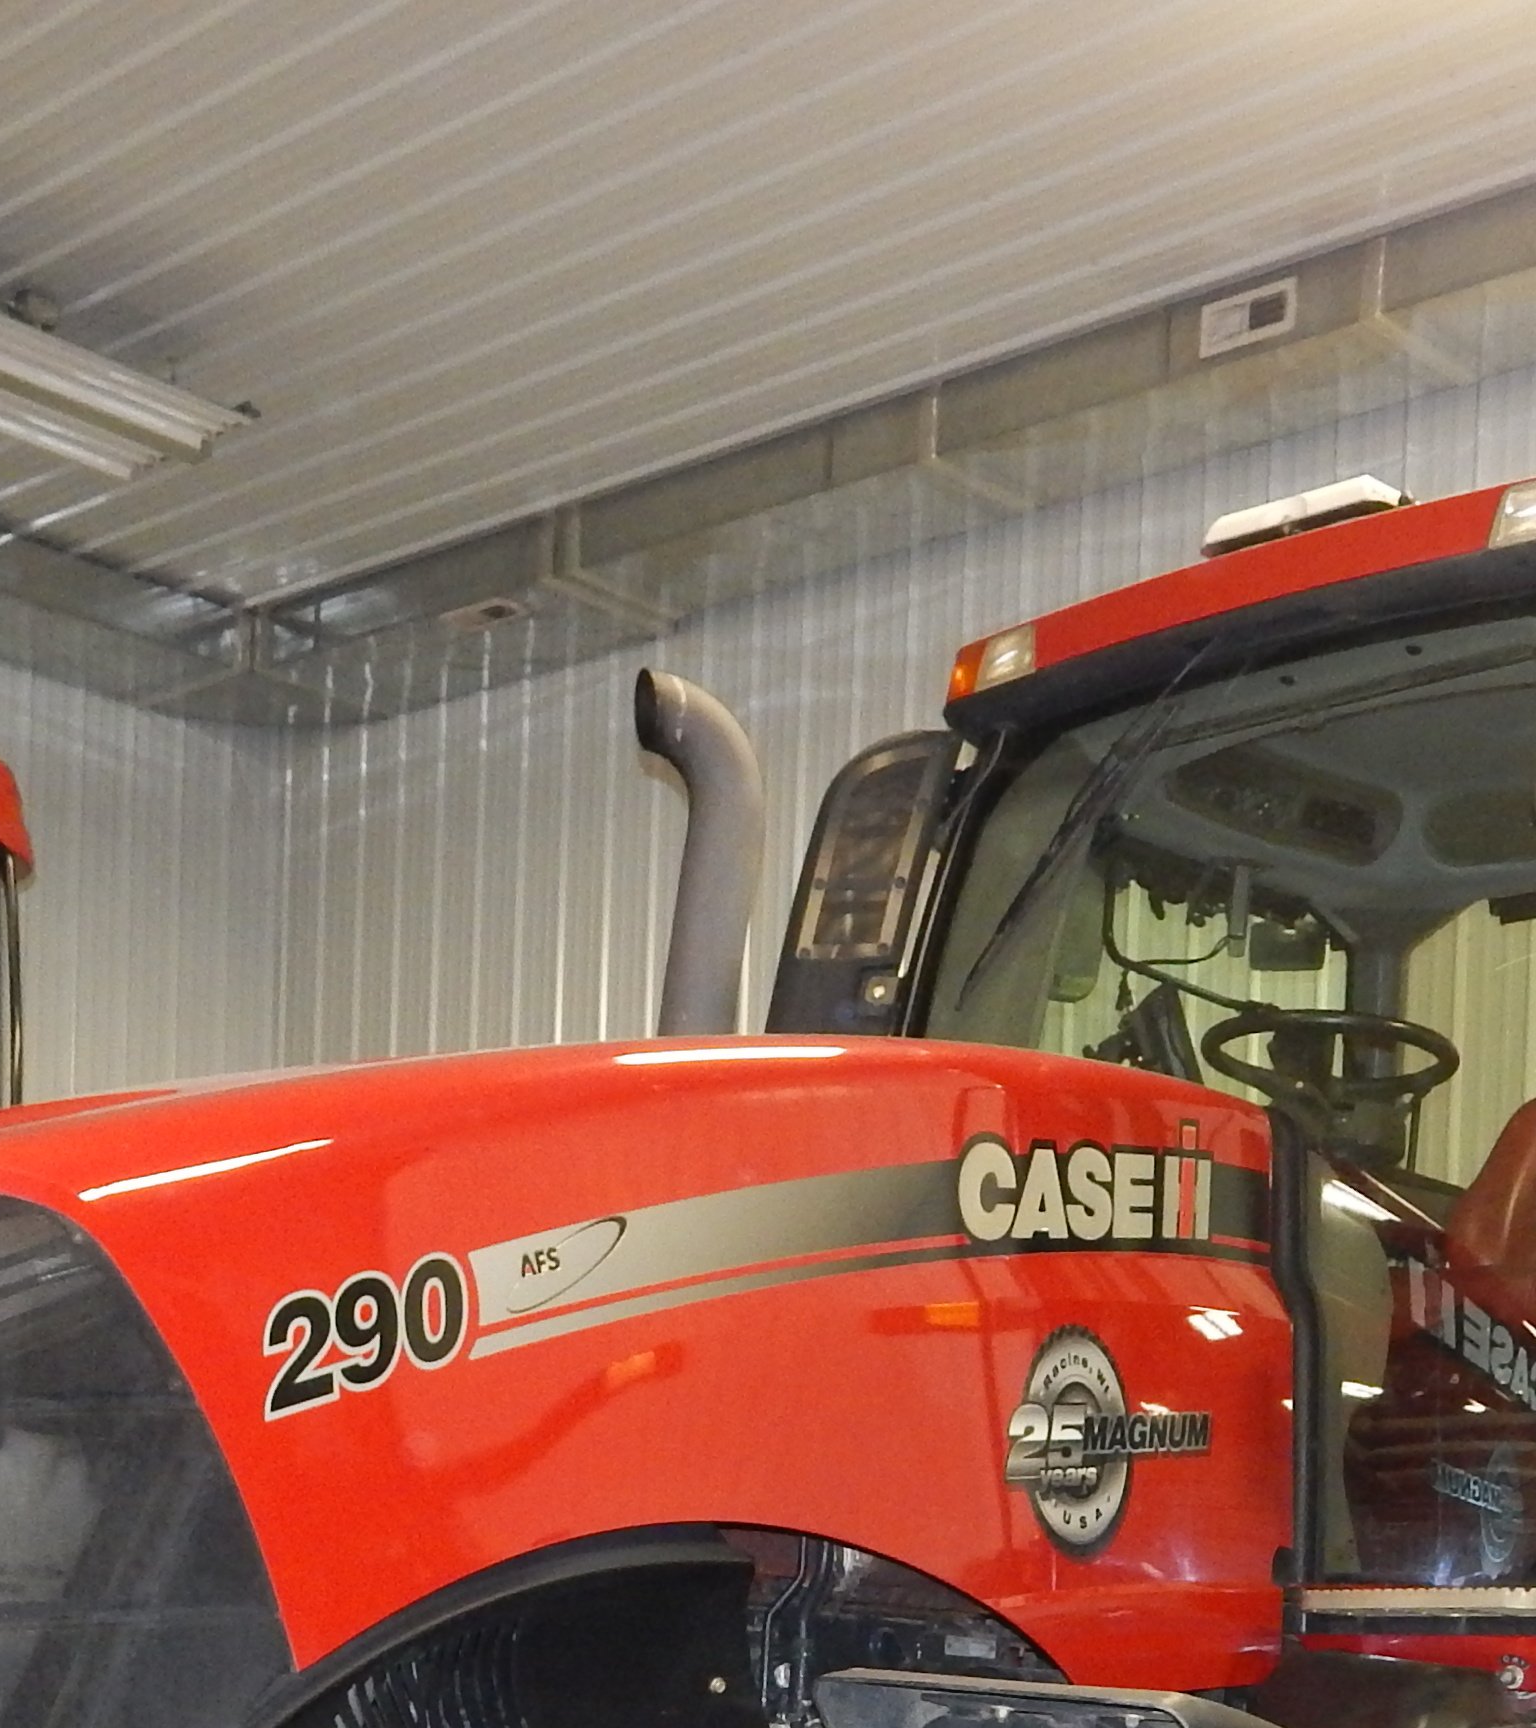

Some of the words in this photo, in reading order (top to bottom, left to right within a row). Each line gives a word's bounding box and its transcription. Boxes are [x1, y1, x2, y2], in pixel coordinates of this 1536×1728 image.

[957, 1141, 1157, 1241] CASE
[520, 1245, 562, 1279] AFS
[264, 1252, 469, 1422] 290
[1005, 1402, 1088, 1482] 25
[1081, 1411, 1211, 1453] MAGNUM
[1040, 1463, 1098, 1494] years
[1062, 1507, 1104, 1530] USA
